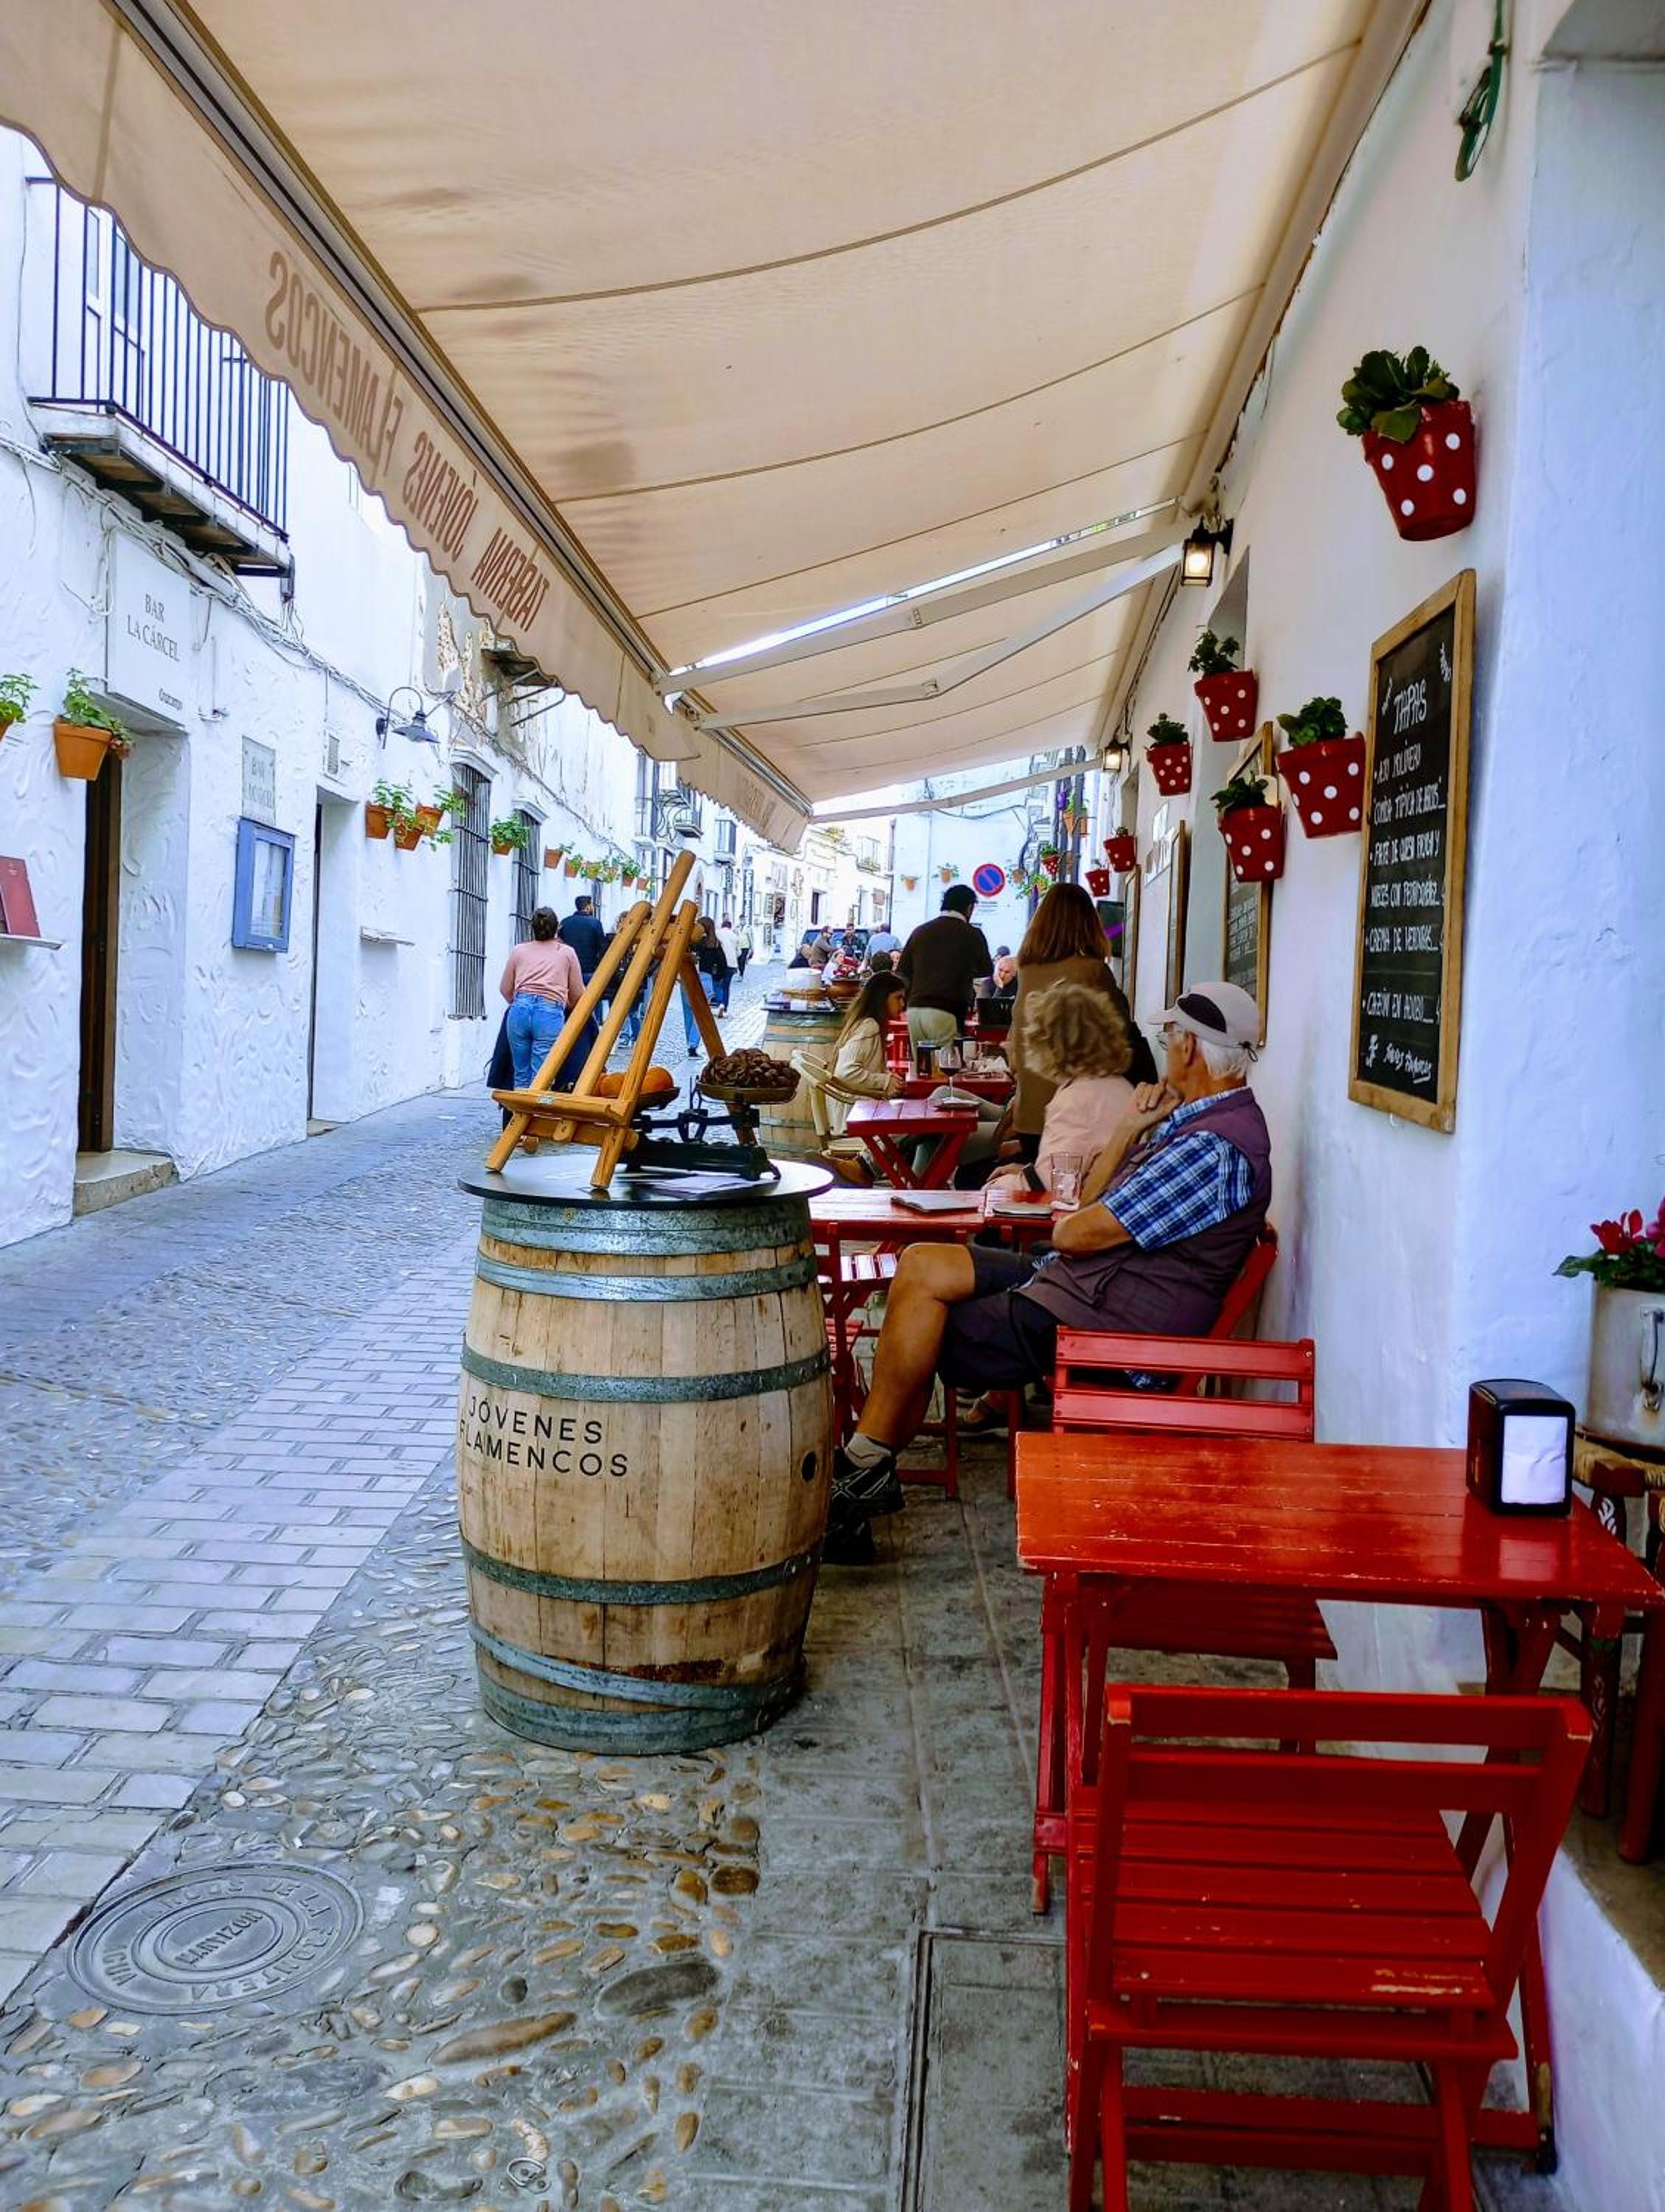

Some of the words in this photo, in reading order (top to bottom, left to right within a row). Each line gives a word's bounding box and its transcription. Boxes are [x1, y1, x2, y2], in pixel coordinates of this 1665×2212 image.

[145, 594, 164, 623] BAR
[1393, 678, 1427, 735] TAPAS
[469, 1396, 602, 1444] JÓVENES
[460, 1419, 628, 1477] FLAMENCOS
